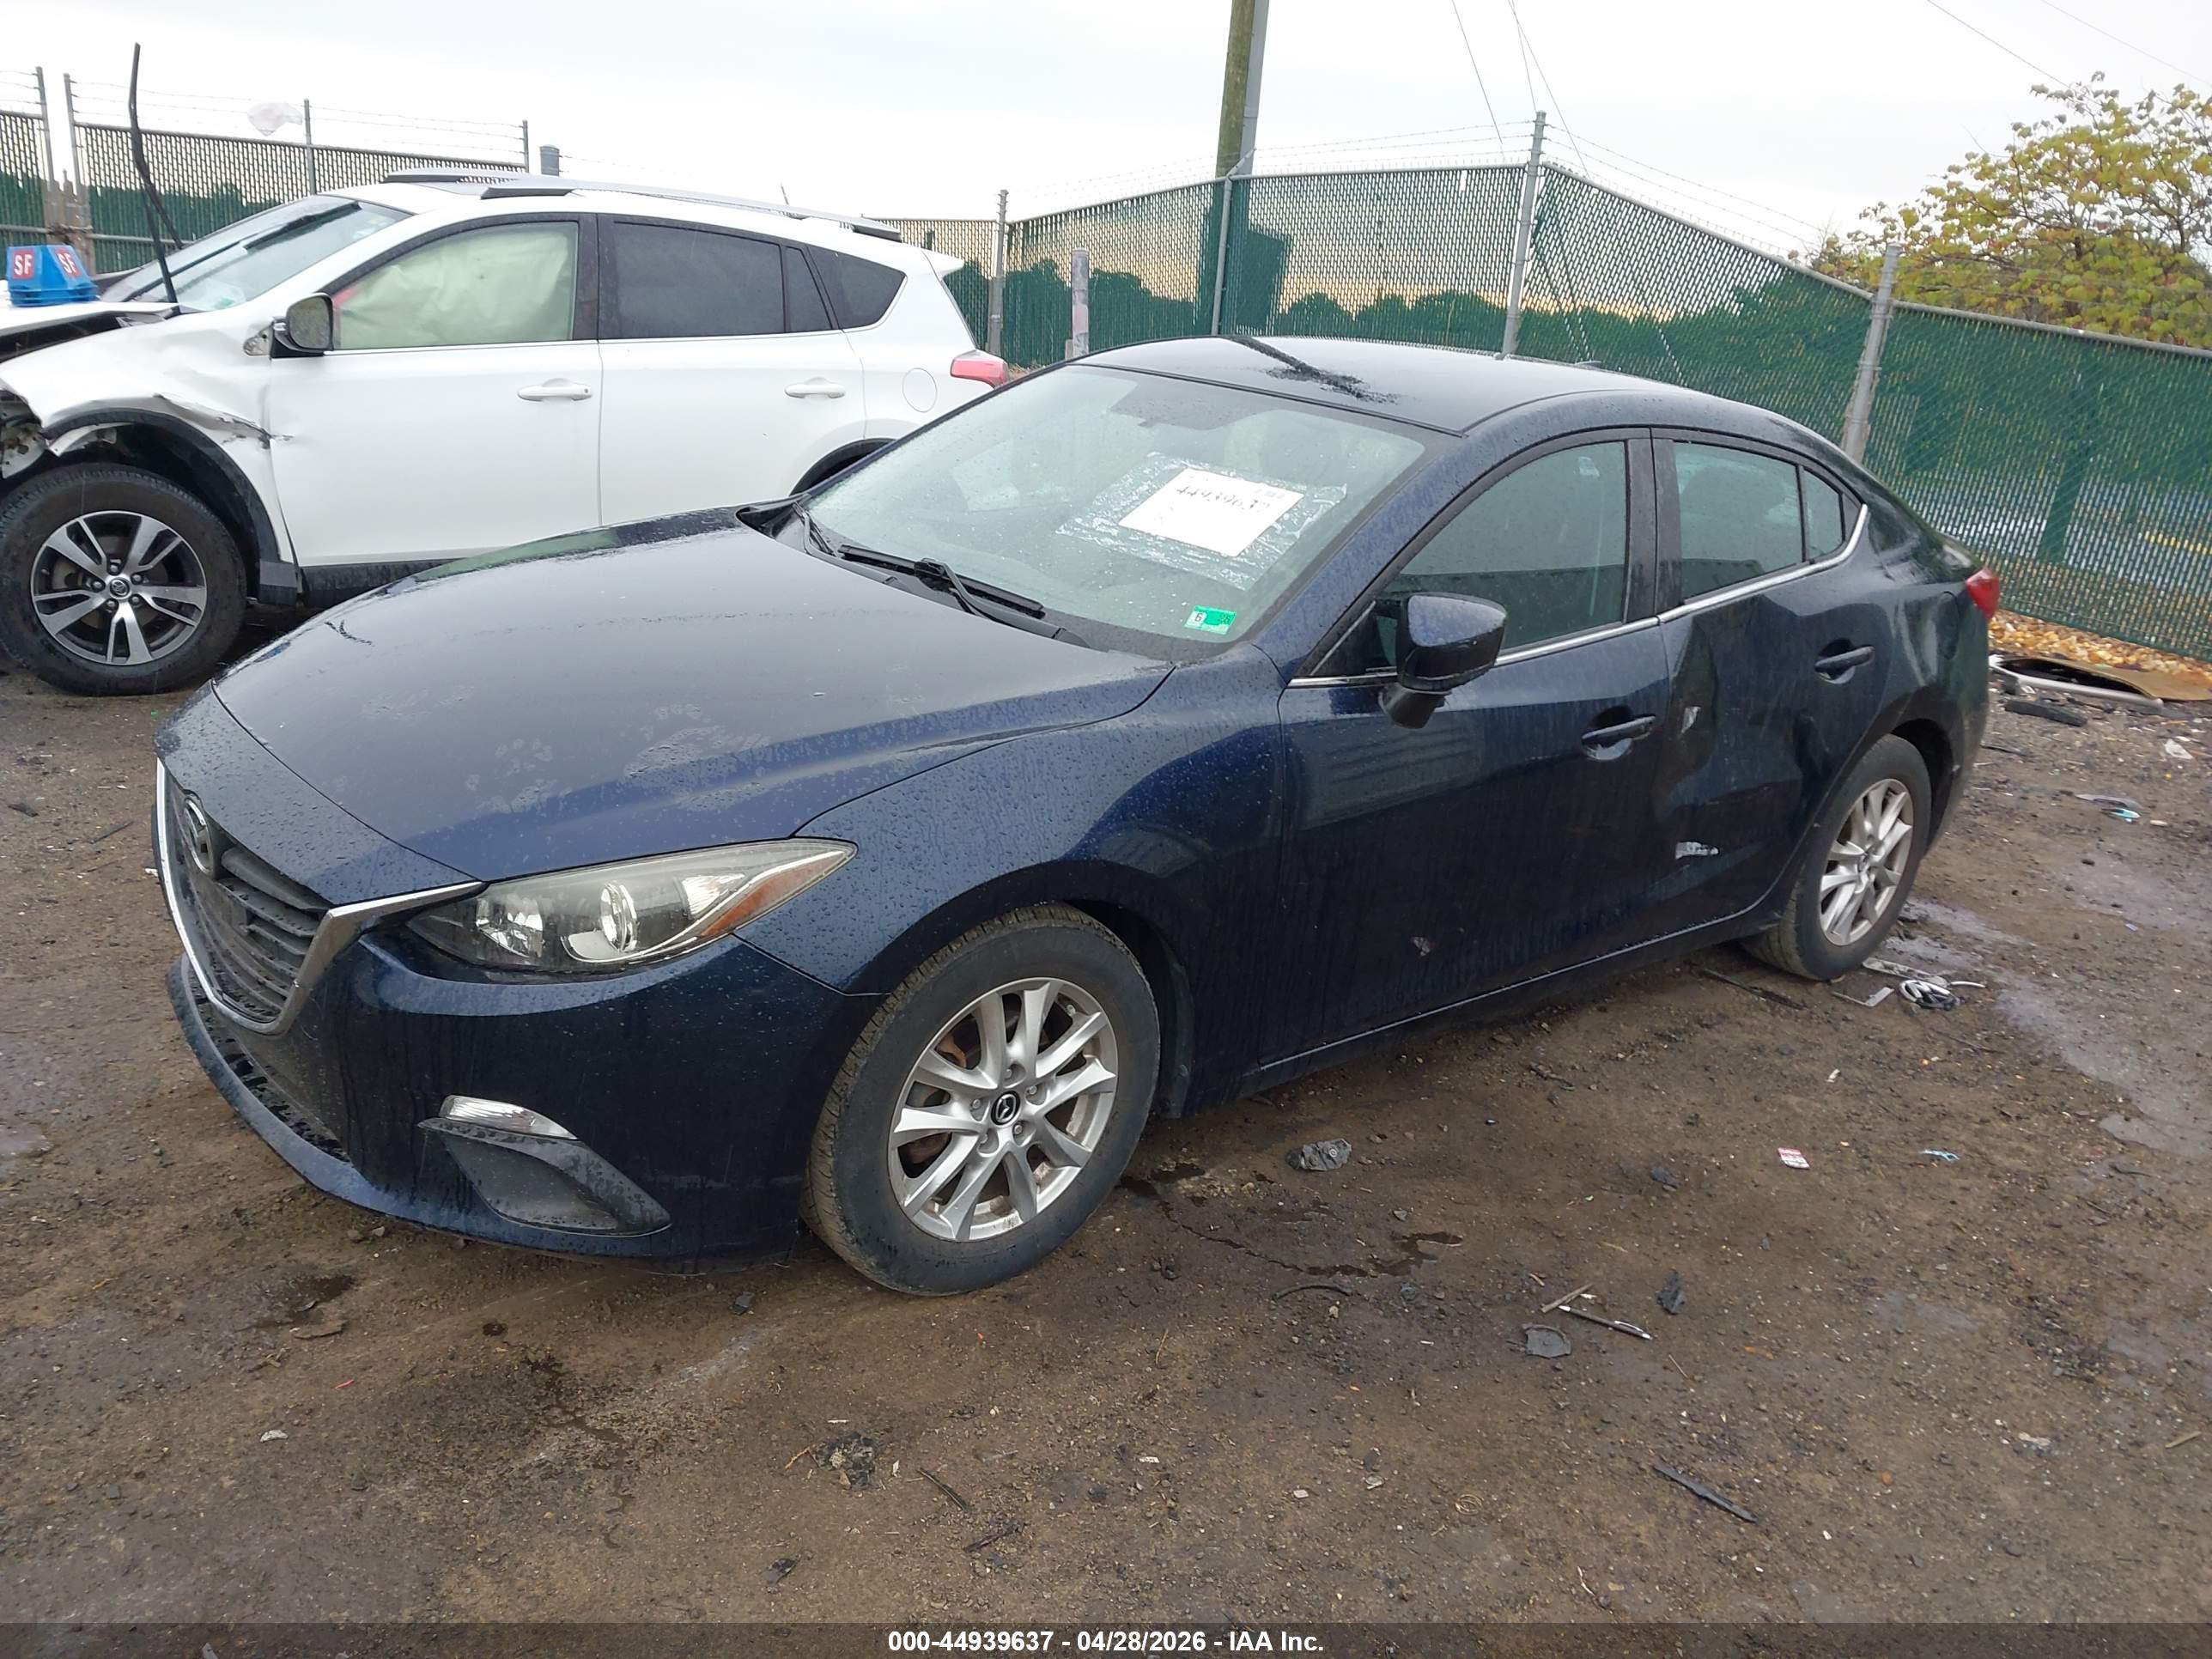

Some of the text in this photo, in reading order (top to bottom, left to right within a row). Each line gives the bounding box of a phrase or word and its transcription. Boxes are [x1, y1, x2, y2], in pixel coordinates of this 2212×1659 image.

[14, 253, 33, 276] SF
[57, 252, 76, 274] SF
[1194, 612, 1203, 623] 6
